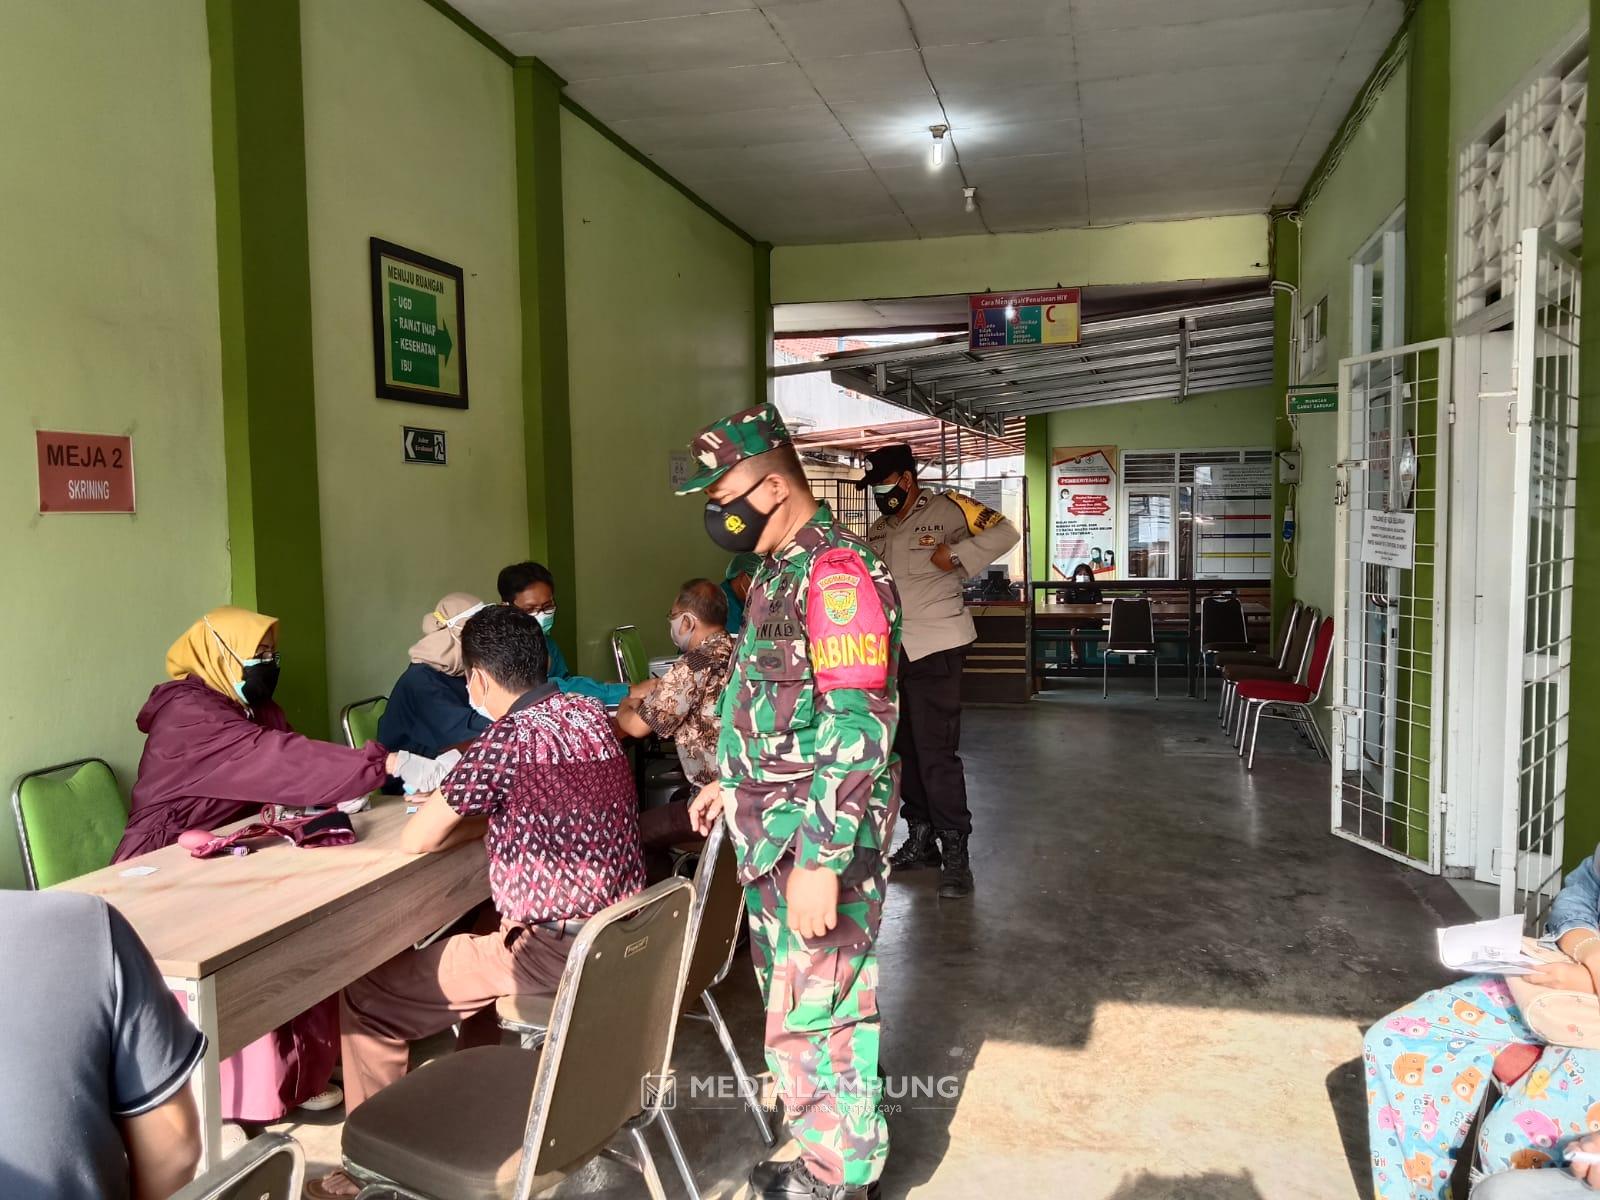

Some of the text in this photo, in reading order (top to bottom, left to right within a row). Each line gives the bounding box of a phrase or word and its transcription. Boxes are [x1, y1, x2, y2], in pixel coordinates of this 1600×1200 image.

[388, 265, 444, 294] MENUJU RUANGAN
[398, 296, 412, 311] UGD
[399, 317, 437, 337] RAWAT INAP
[400, 338, 436, 356] KESEHATAN
[401, 360, 412, 372] IBU
[47, 444, 123, 469] MEJA 2
[68, 479, 110, 500] SKRINING
[915, 524, 944, 533] POLRI
